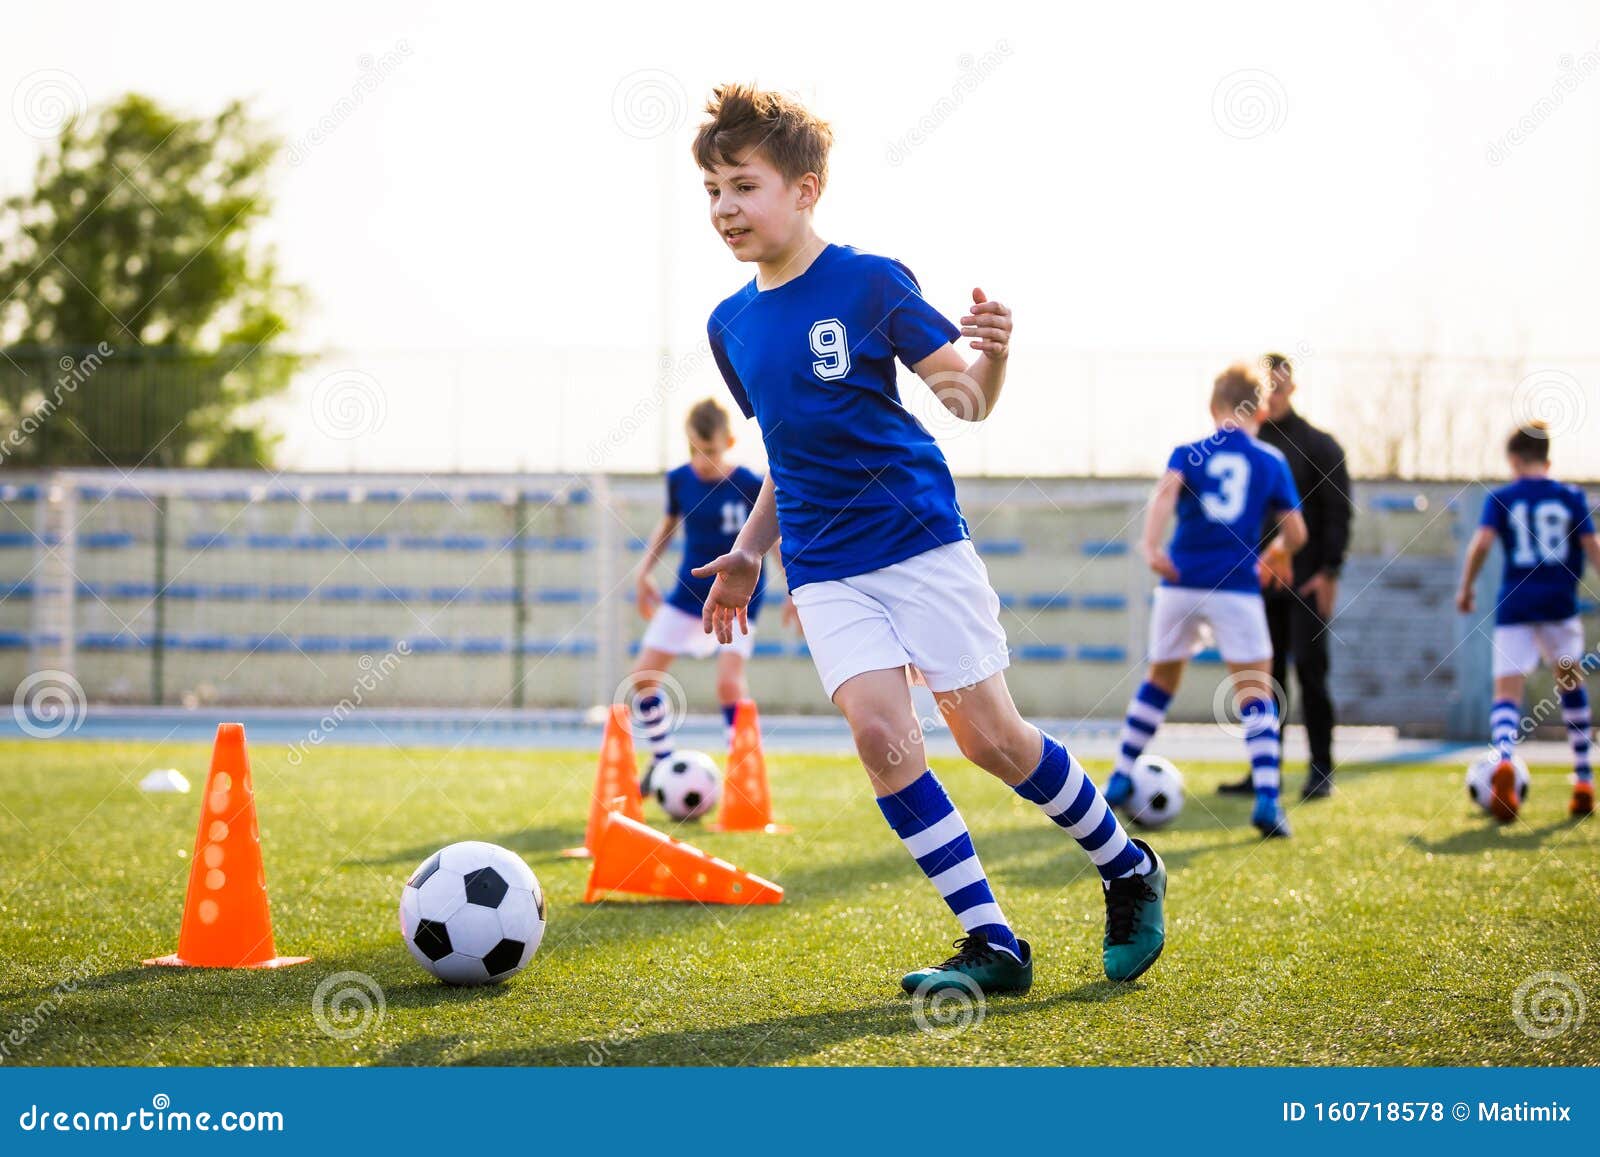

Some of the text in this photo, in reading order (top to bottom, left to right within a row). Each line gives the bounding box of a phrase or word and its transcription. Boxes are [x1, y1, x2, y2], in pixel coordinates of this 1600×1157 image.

[808, 318, 850, 381] 9
[722, 502, 747, 534] 11
[1203, 452, 1251, 523] 3
[1508, 501, 1570, 566] 18
